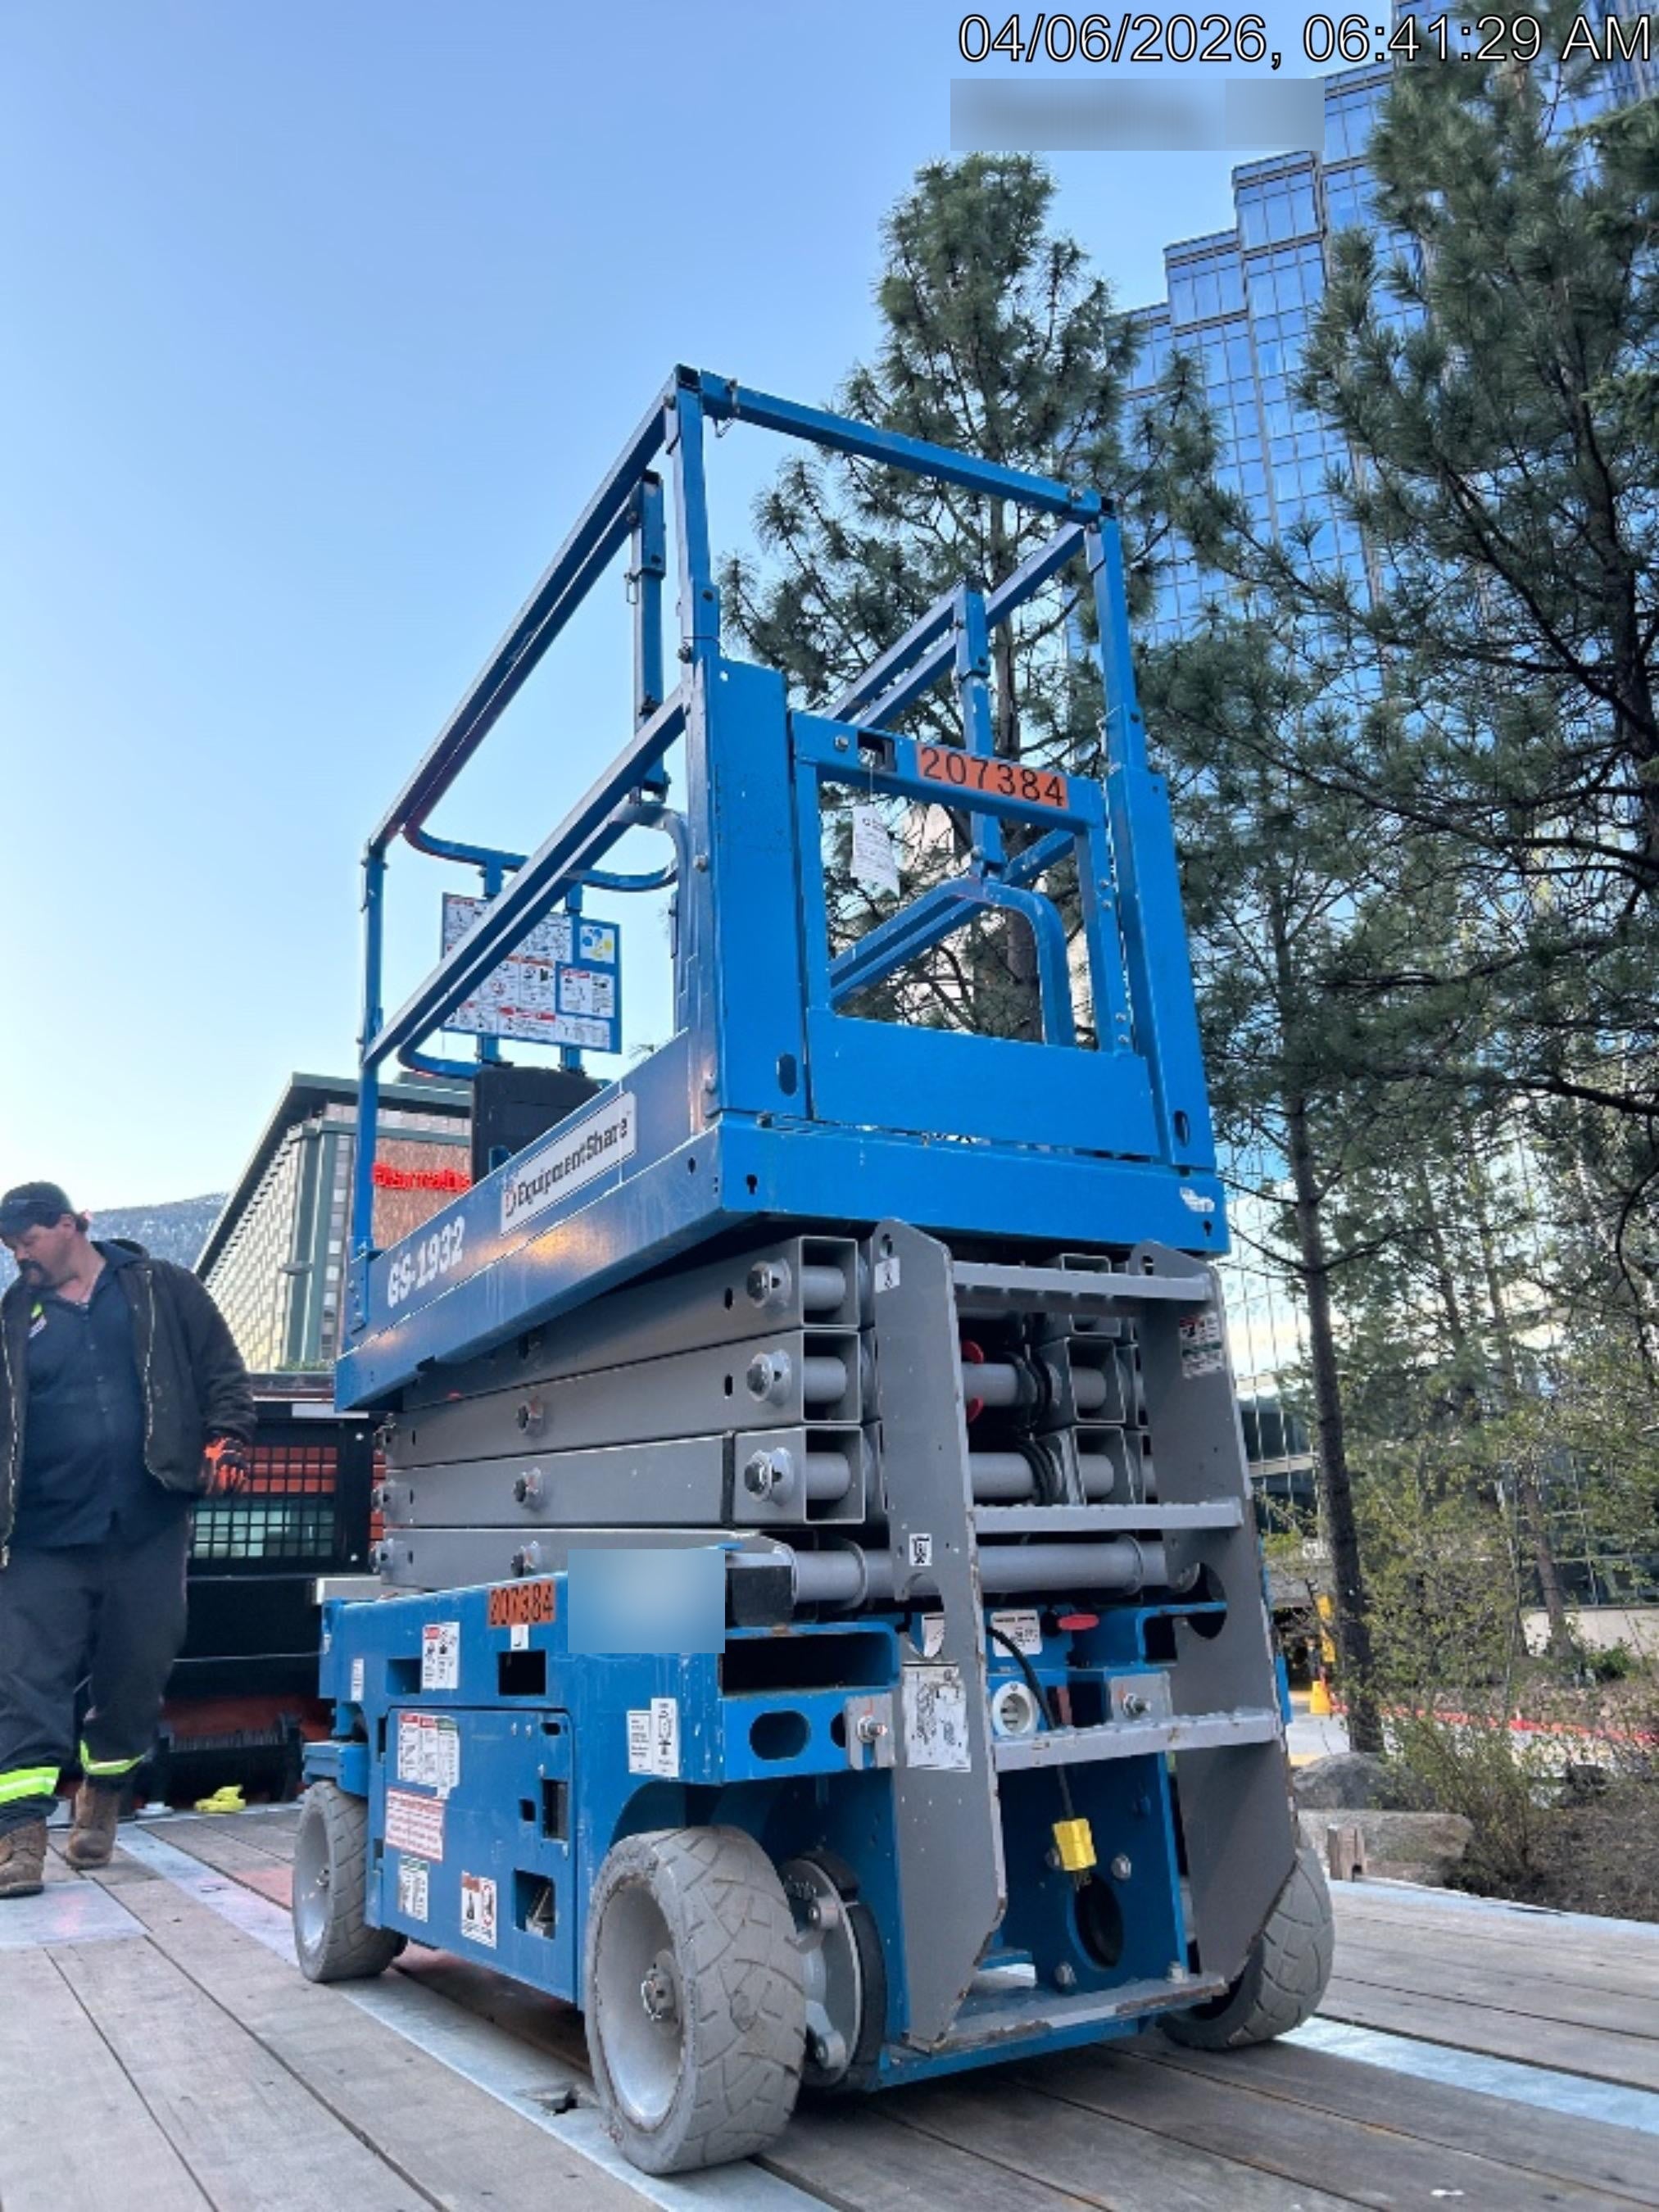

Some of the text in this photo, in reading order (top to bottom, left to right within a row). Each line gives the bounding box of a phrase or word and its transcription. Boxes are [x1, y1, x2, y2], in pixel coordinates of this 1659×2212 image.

[920, 746, 1064, 807] 207384
[518, 1117, 628, 1208] EquipmentShare
[388, 1216, 465, 1308] GS-1932
